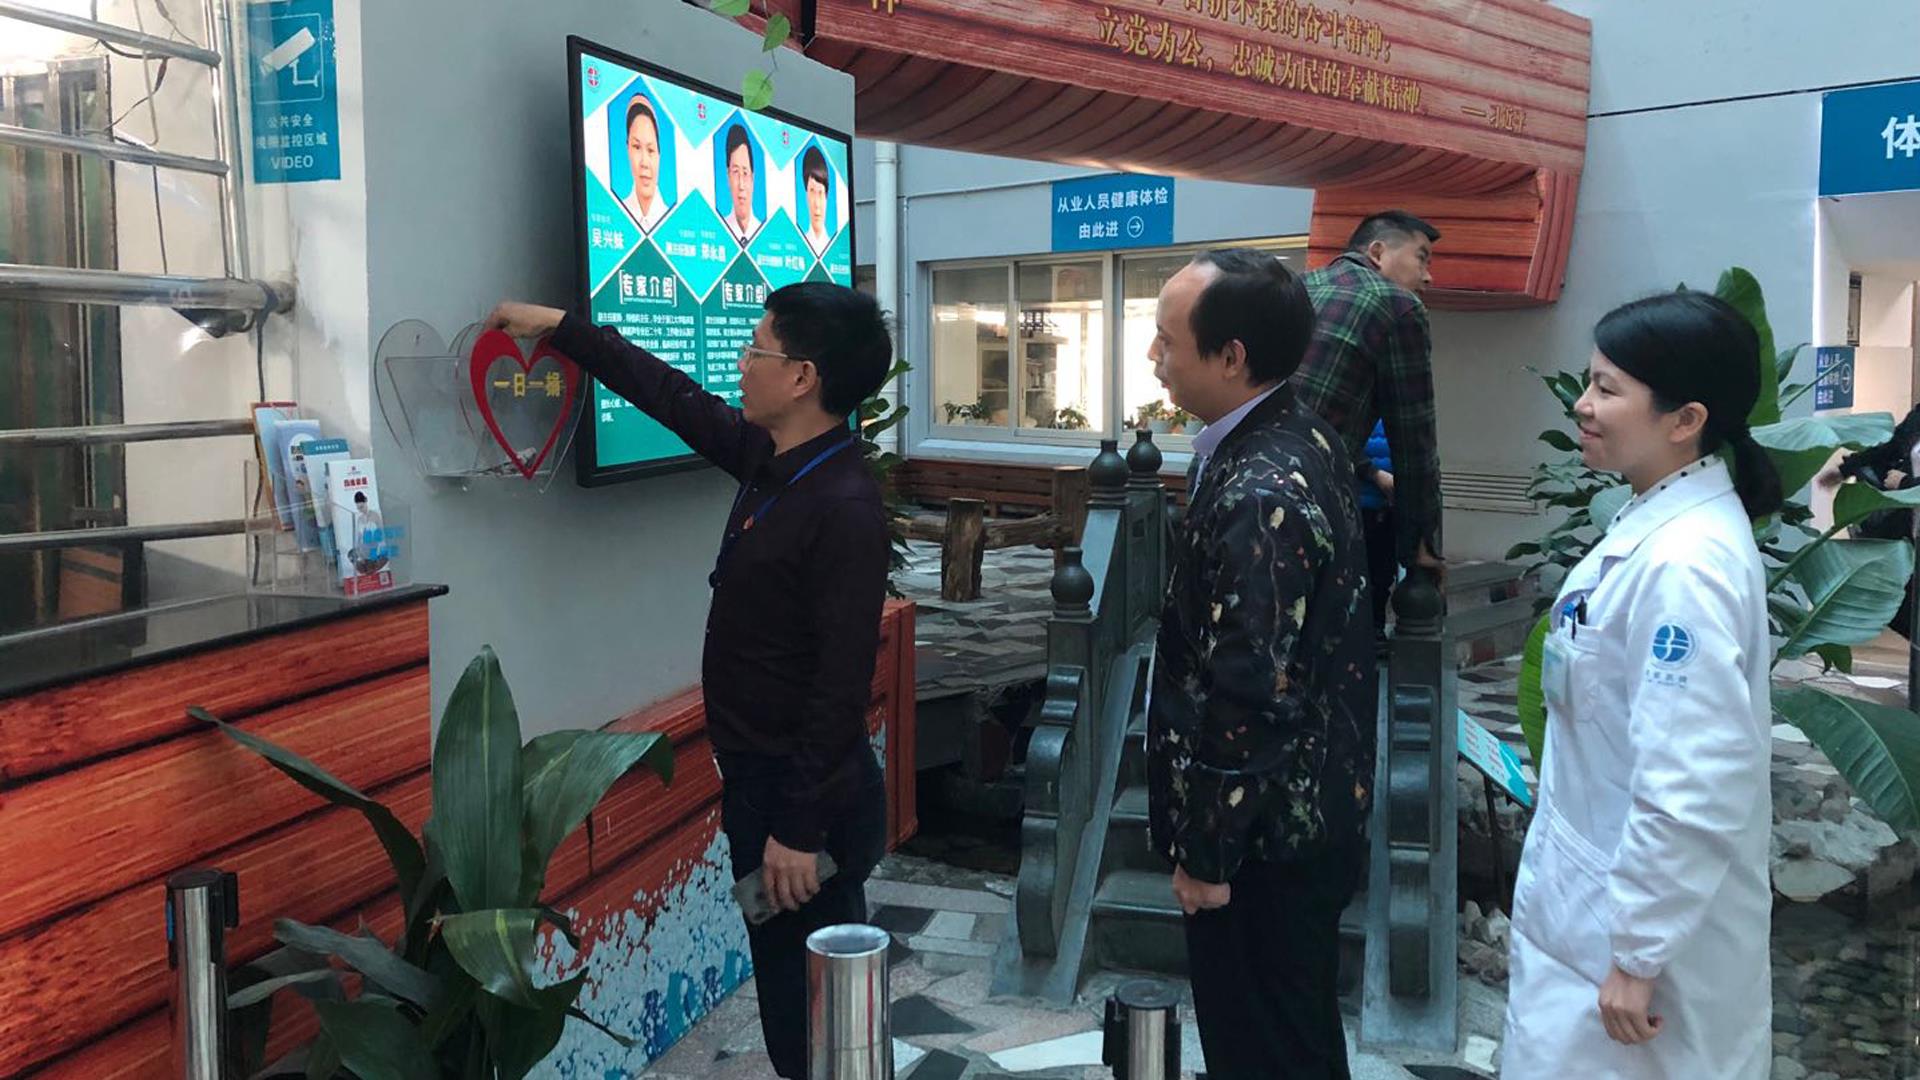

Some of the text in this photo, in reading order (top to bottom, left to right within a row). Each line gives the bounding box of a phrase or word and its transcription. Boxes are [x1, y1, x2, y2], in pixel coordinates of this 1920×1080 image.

[267, 113, 313, 129] 公共安全
[1880, 114, 1920, 160] 体
[270, 154, 314, 170] VIDEO
[1057, 186, 1168, 213] 从业人员健康体检
[1079, 220, 1119, 239] 由此进
[622, 273, 673, 298] 专家介绍
